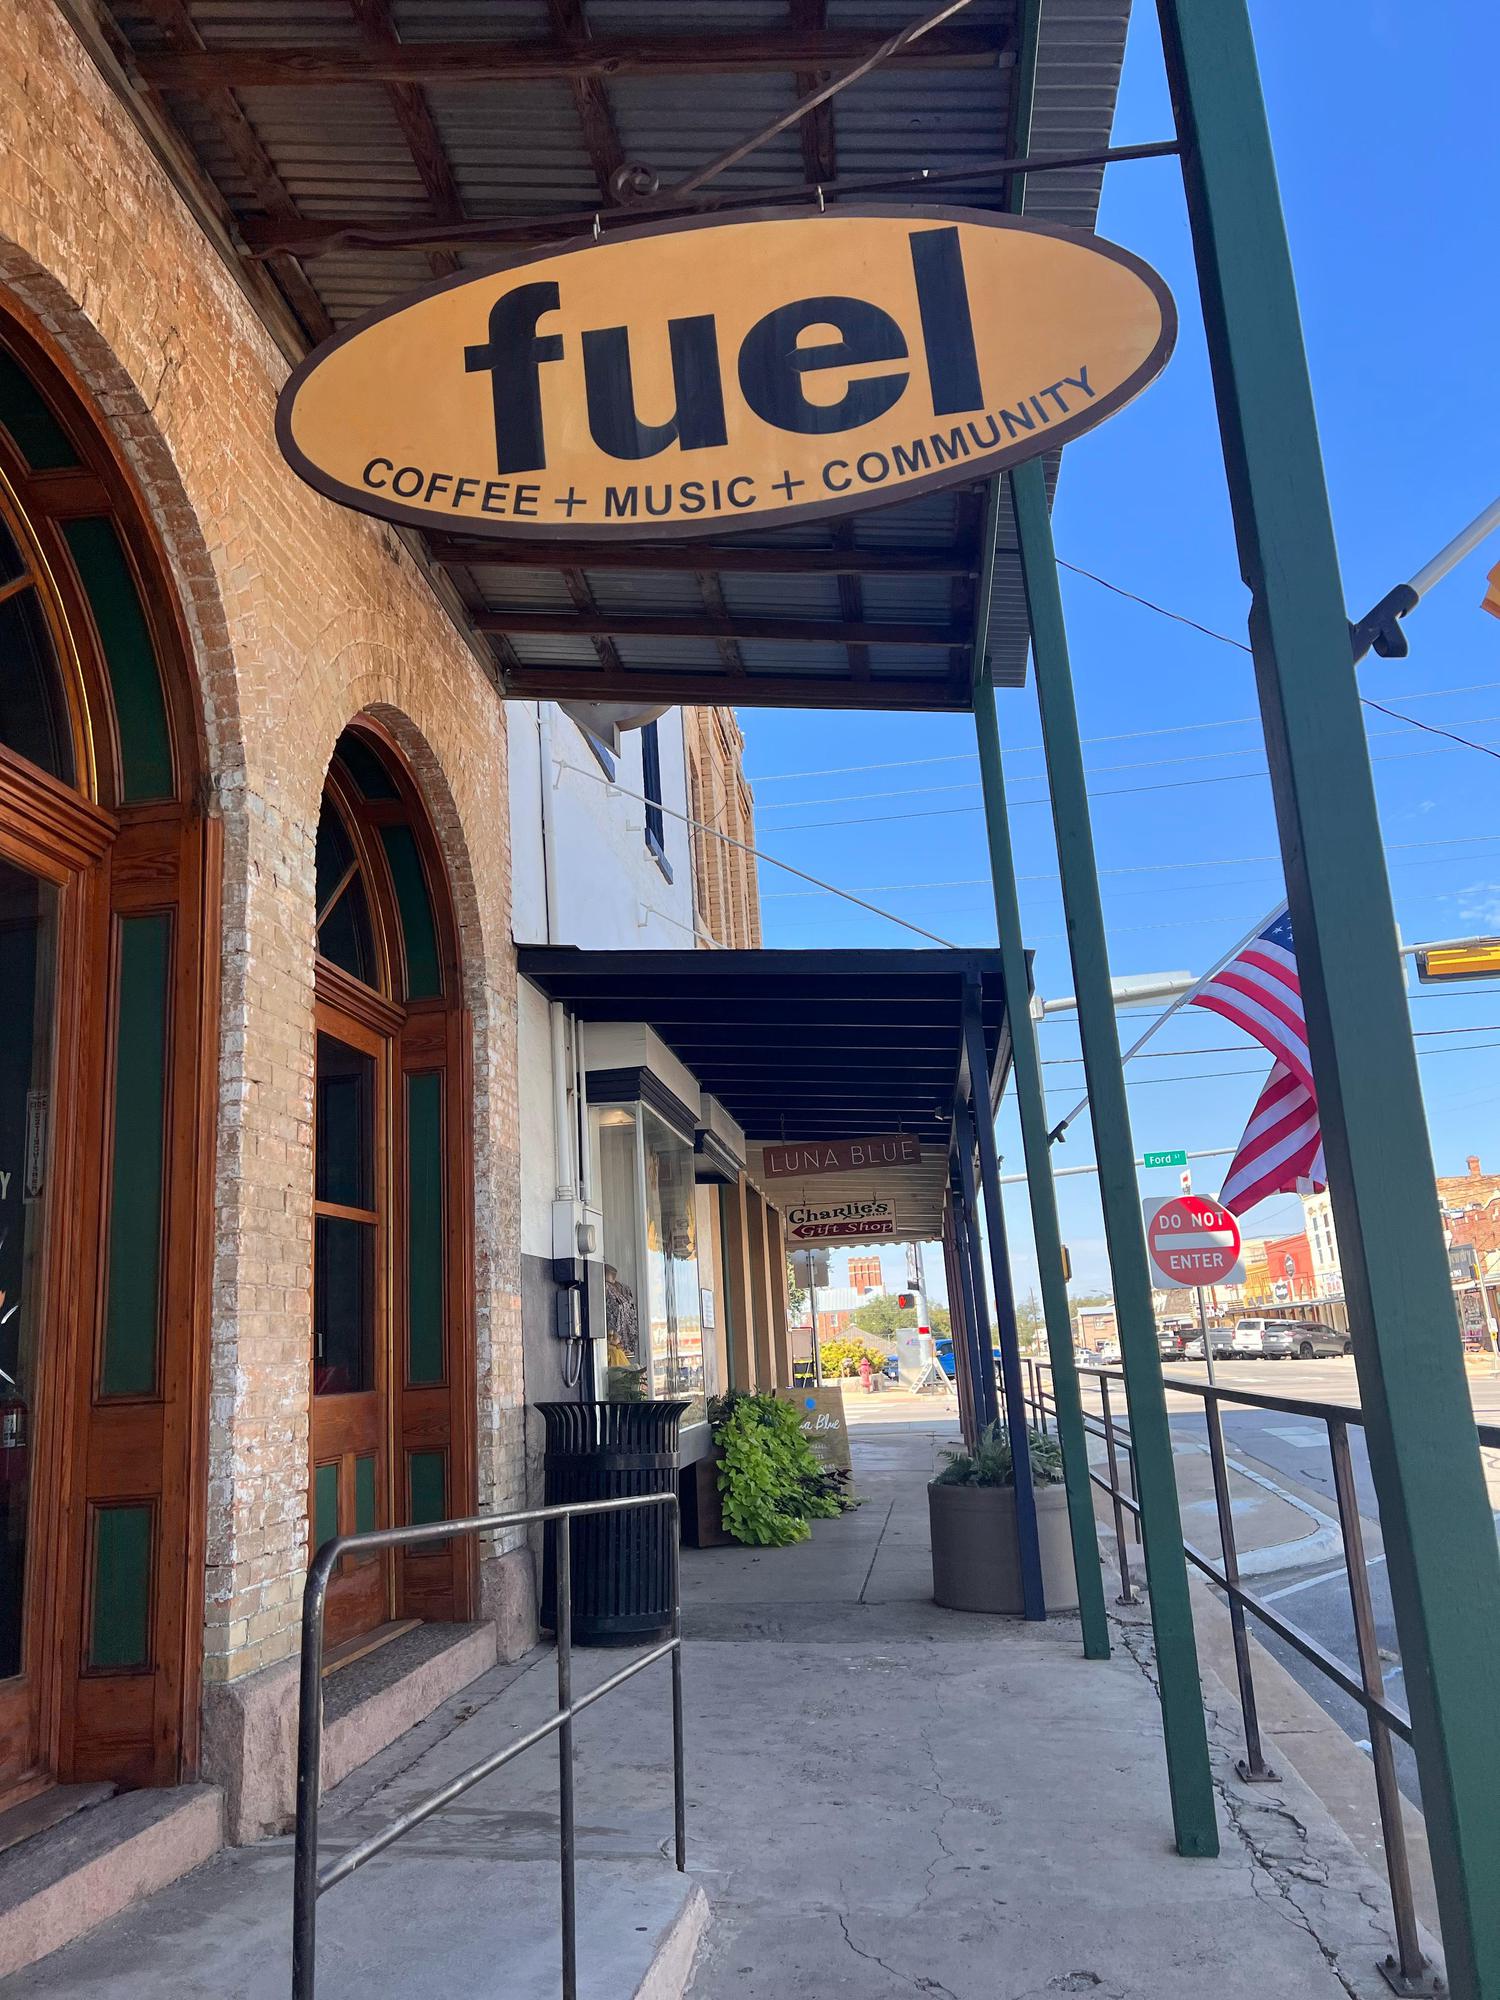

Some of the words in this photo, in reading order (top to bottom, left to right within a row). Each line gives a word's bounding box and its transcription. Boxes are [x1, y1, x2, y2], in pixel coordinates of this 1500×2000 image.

[463, 225, 985, 475] fuel
[361, 457, 541, 517] COFFEE
[604, 475, 758, 518] MUSIC
[821, 365, 1098, 492] COMMUNITY
[770, 1149, 839, 1173] LUNA
[851, 1141, 915, 1165] BLUE
[1149, 1155, 1171, 1164] Ford
[789, 1202, 888, 1224] Charlie's
[1159, 1214, 1182, 1229] DO
[1191, 1211, 1224, 1227] NOT
[801, 1223, 839, 1236] Gift
[845, 1221, 892, 1233] Shop
[1170, 1253, 1224, 1270] ENTER
[815, 1413, 840, 1430] Blue
